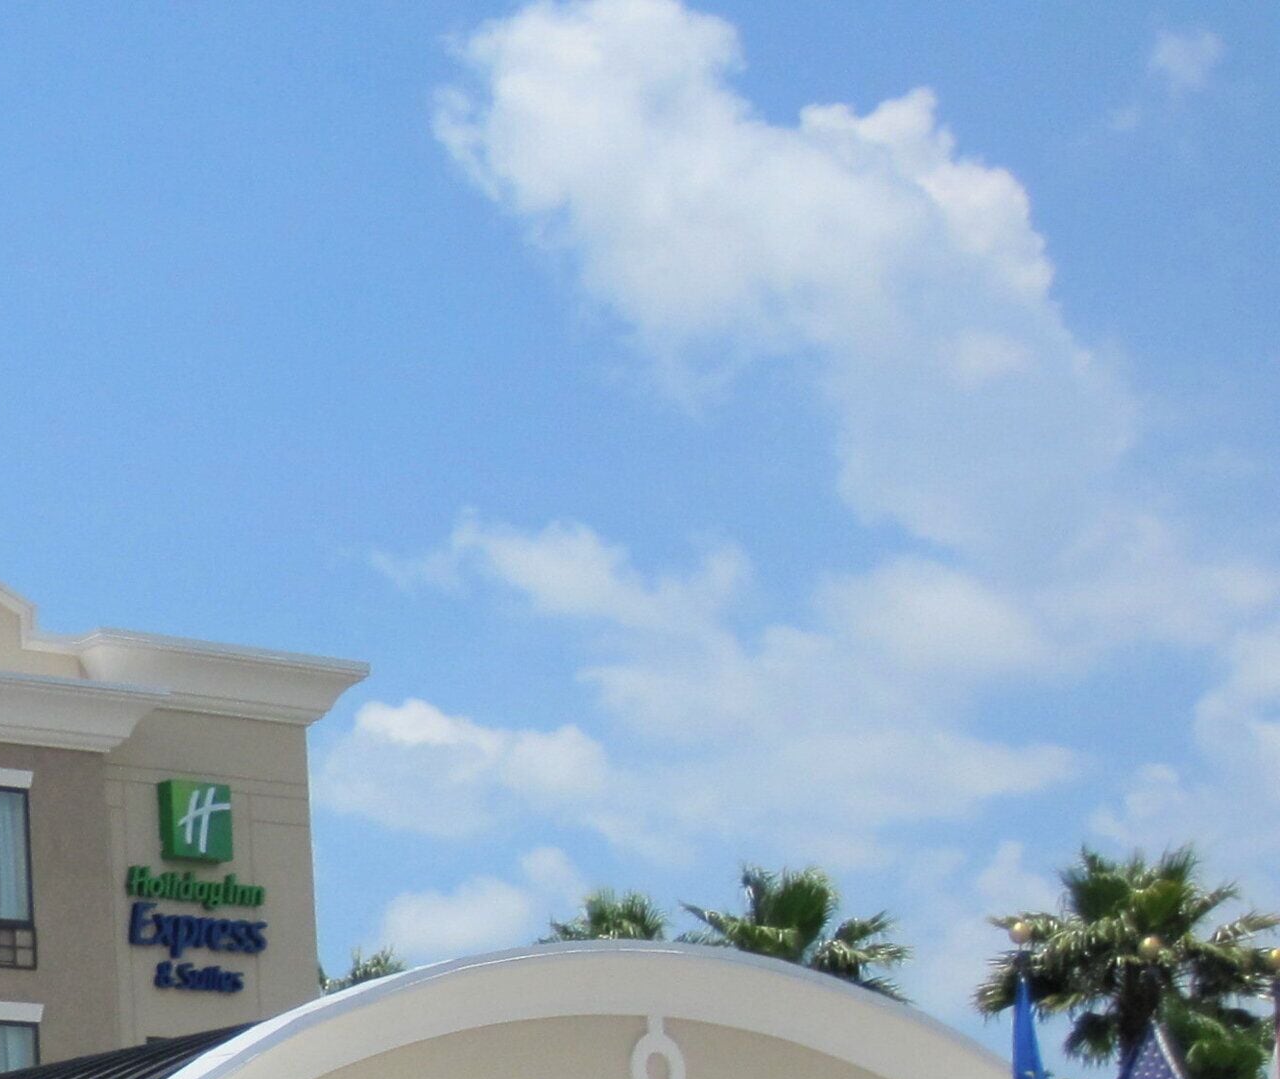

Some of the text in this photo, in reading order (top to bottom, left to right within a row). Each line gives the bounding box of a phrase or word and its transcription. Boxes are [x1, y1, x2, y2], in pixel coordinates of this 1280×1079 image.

[128, 901, 268, 958] Express
[153, 960, 244, 992] & Suites
